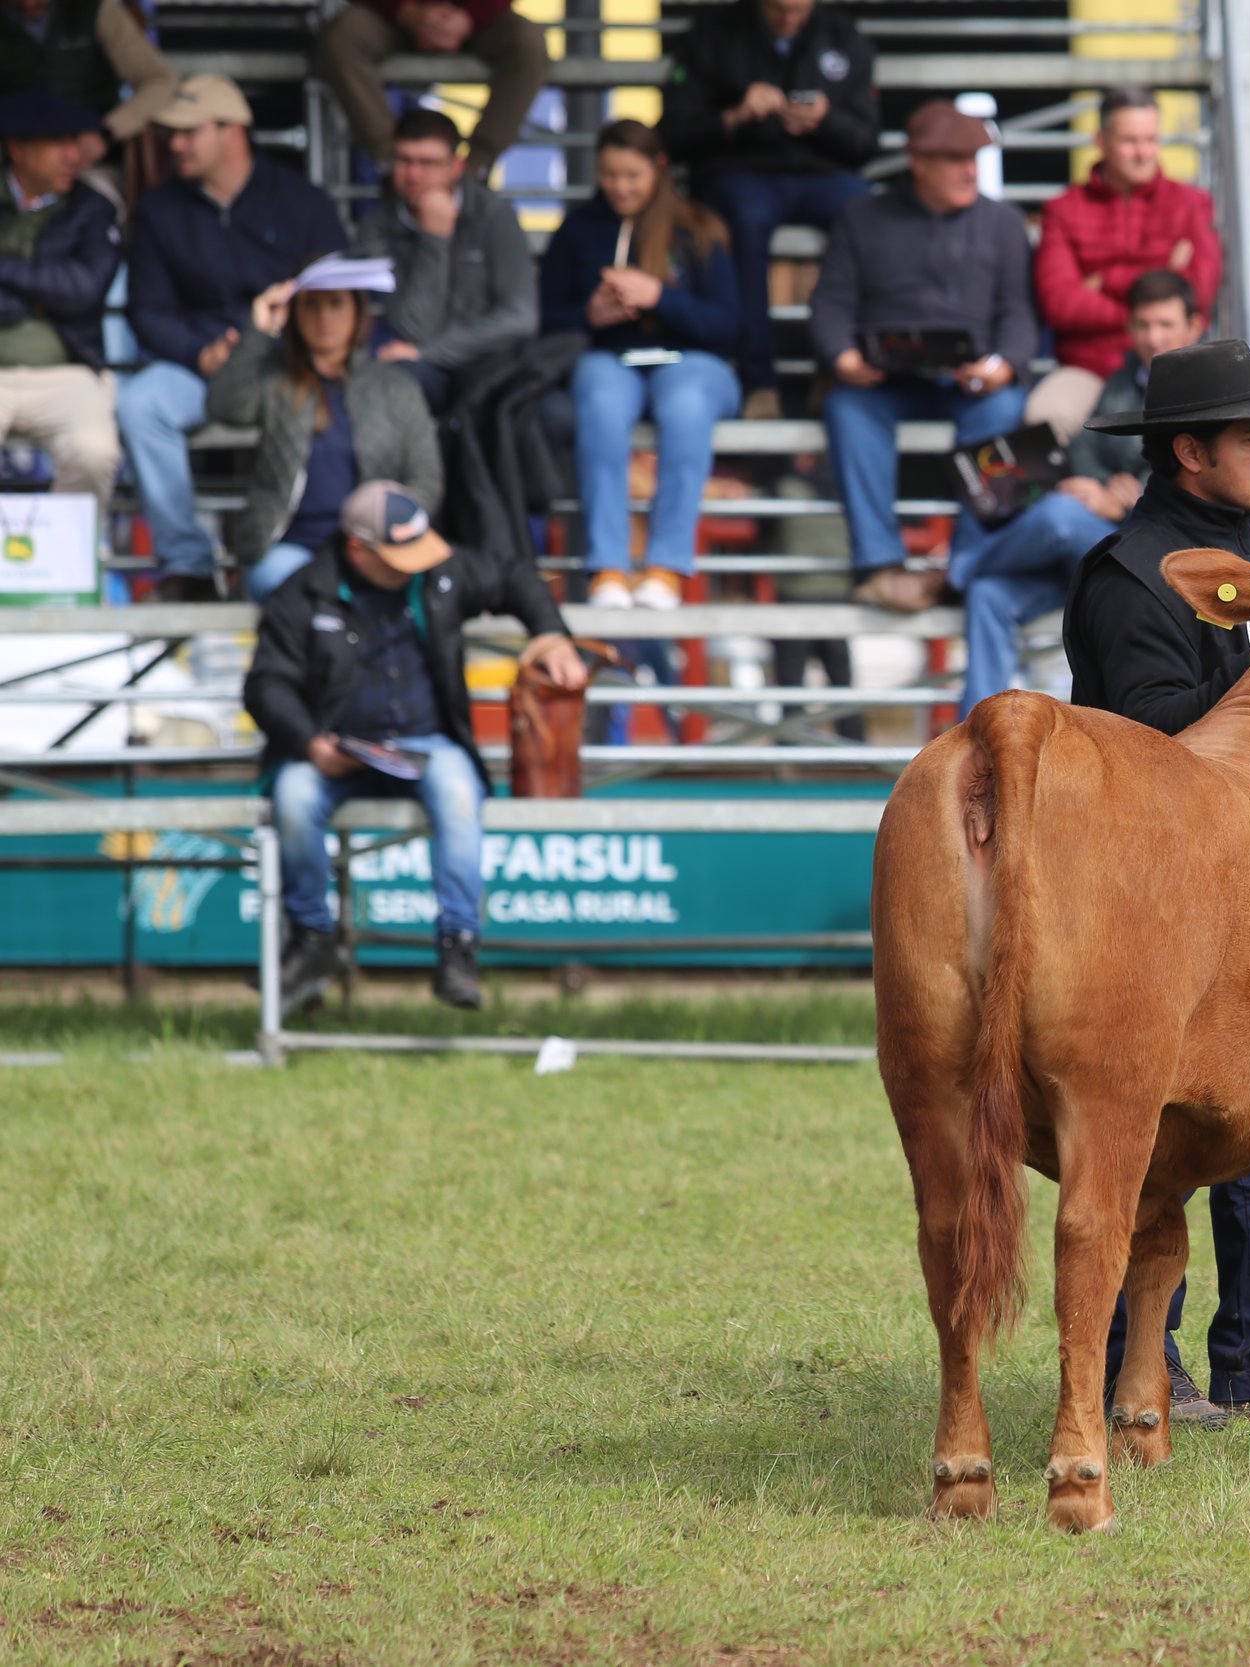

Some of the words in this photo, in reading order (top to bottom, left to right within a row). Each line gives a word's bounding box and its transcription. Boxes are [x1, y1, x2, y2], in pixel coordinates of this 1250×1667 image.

[481, 834, 677, 882] FARSUL
[487, 889, 572, 923] CASA
[574, 889, 679, 923] RURAL
